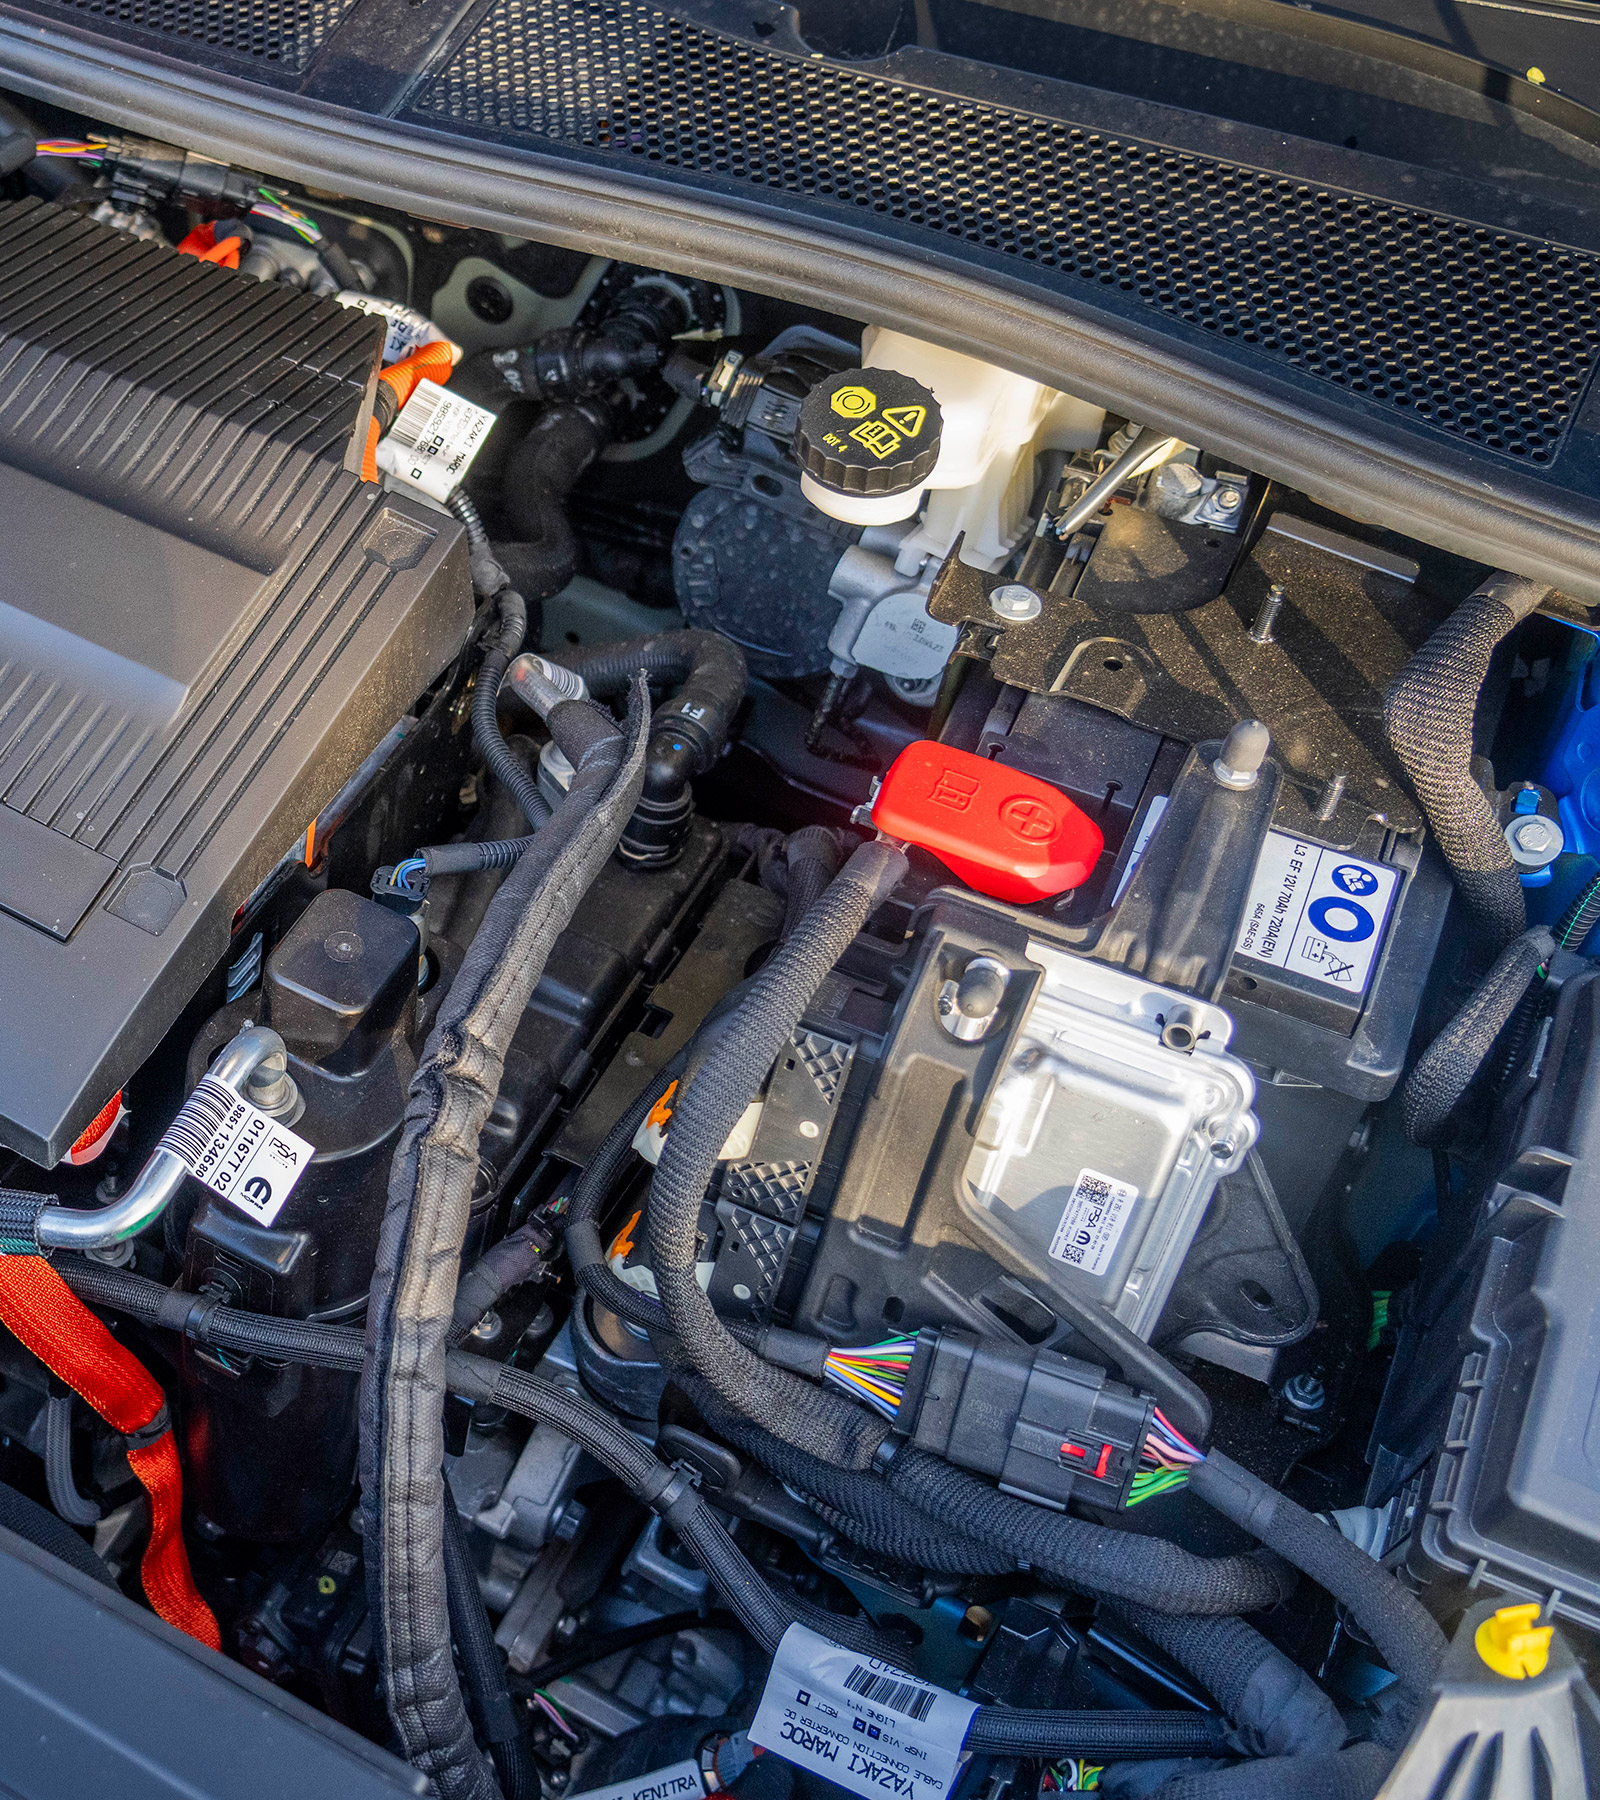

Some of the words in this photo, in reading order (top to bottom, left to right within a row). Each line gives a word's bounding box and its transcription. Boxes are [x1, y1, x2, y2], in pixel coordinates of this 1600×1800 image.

[464, 415, 488, 448] YAZAKI
[822, 432, 841, 447] DOT
[838, 445, 848, 453] 4
[446, 452, 467, 475] MAROC
[681, 702, 705, 720] F1
[1294, 844, 1308, 857] L3
[1289, 859, 1303, 874] EF
[1283, 874, 1298, 892] 12V
[1252, 902, 1266, 920] 645A
[1274, 891, 1293, 914] 70Ah
[1256, 914, 1284, 959] 720A(EN)
[225, 1104, 246, 1131] 9851
[227, 1119, 265, 1173] 01167T
[268, 1137, 298, 1166] PSA
[213, 1171, 232, 1191] 02
[1085, 1205, 1103, 1228] PSA
[783, 1707, 797, 1719] DC
[867, 1708, 896, 1729] LIGNE
[779, 1721, 840, 1762] MAROC
[799, 1715, 851, 1746] CONVERTER
[852, 1740, 910, 1774] CONNECTION
[847, 1753, 914, 1800] YAZAKI
[913, 1769, 944, 1790] CABLE
